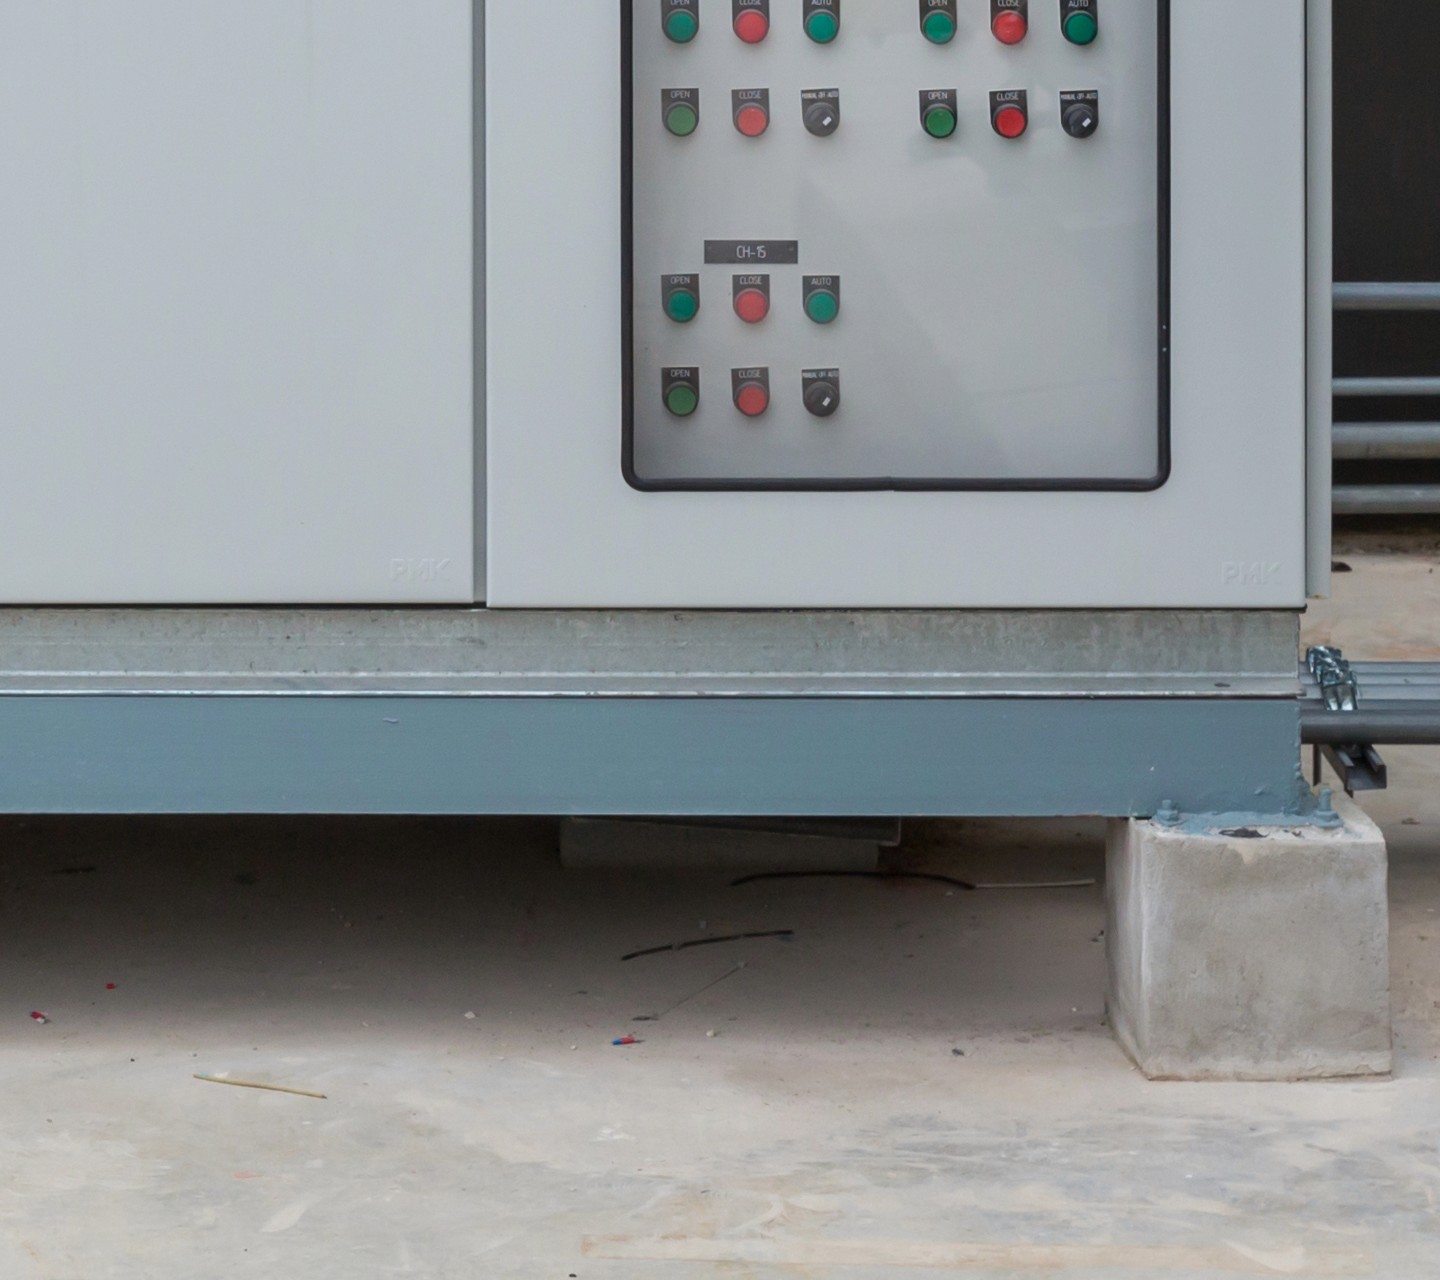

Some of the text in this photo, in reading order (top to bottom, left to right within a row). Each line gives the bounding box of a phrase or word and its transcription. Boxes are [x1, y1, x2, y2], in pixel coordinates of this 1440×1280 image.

[1069, 0, 1090, 7] AUTO
[671, 90, 690, 99] OPEN
[739, 91, 762, 99] CLOSE
[928, 91, 948, 100] OPEN
[997, 92, 1019, 101] CLOSE
[736, 245, 766, 258] CH-15
[671, 276, 690, 285] OPEN
[740, 276, 762, 285] CLOSE
[811, 277, 832, 285] AUTO
[671, 369, 690, 378] OPEN
[739, 369, 762, 378] CLOSE
